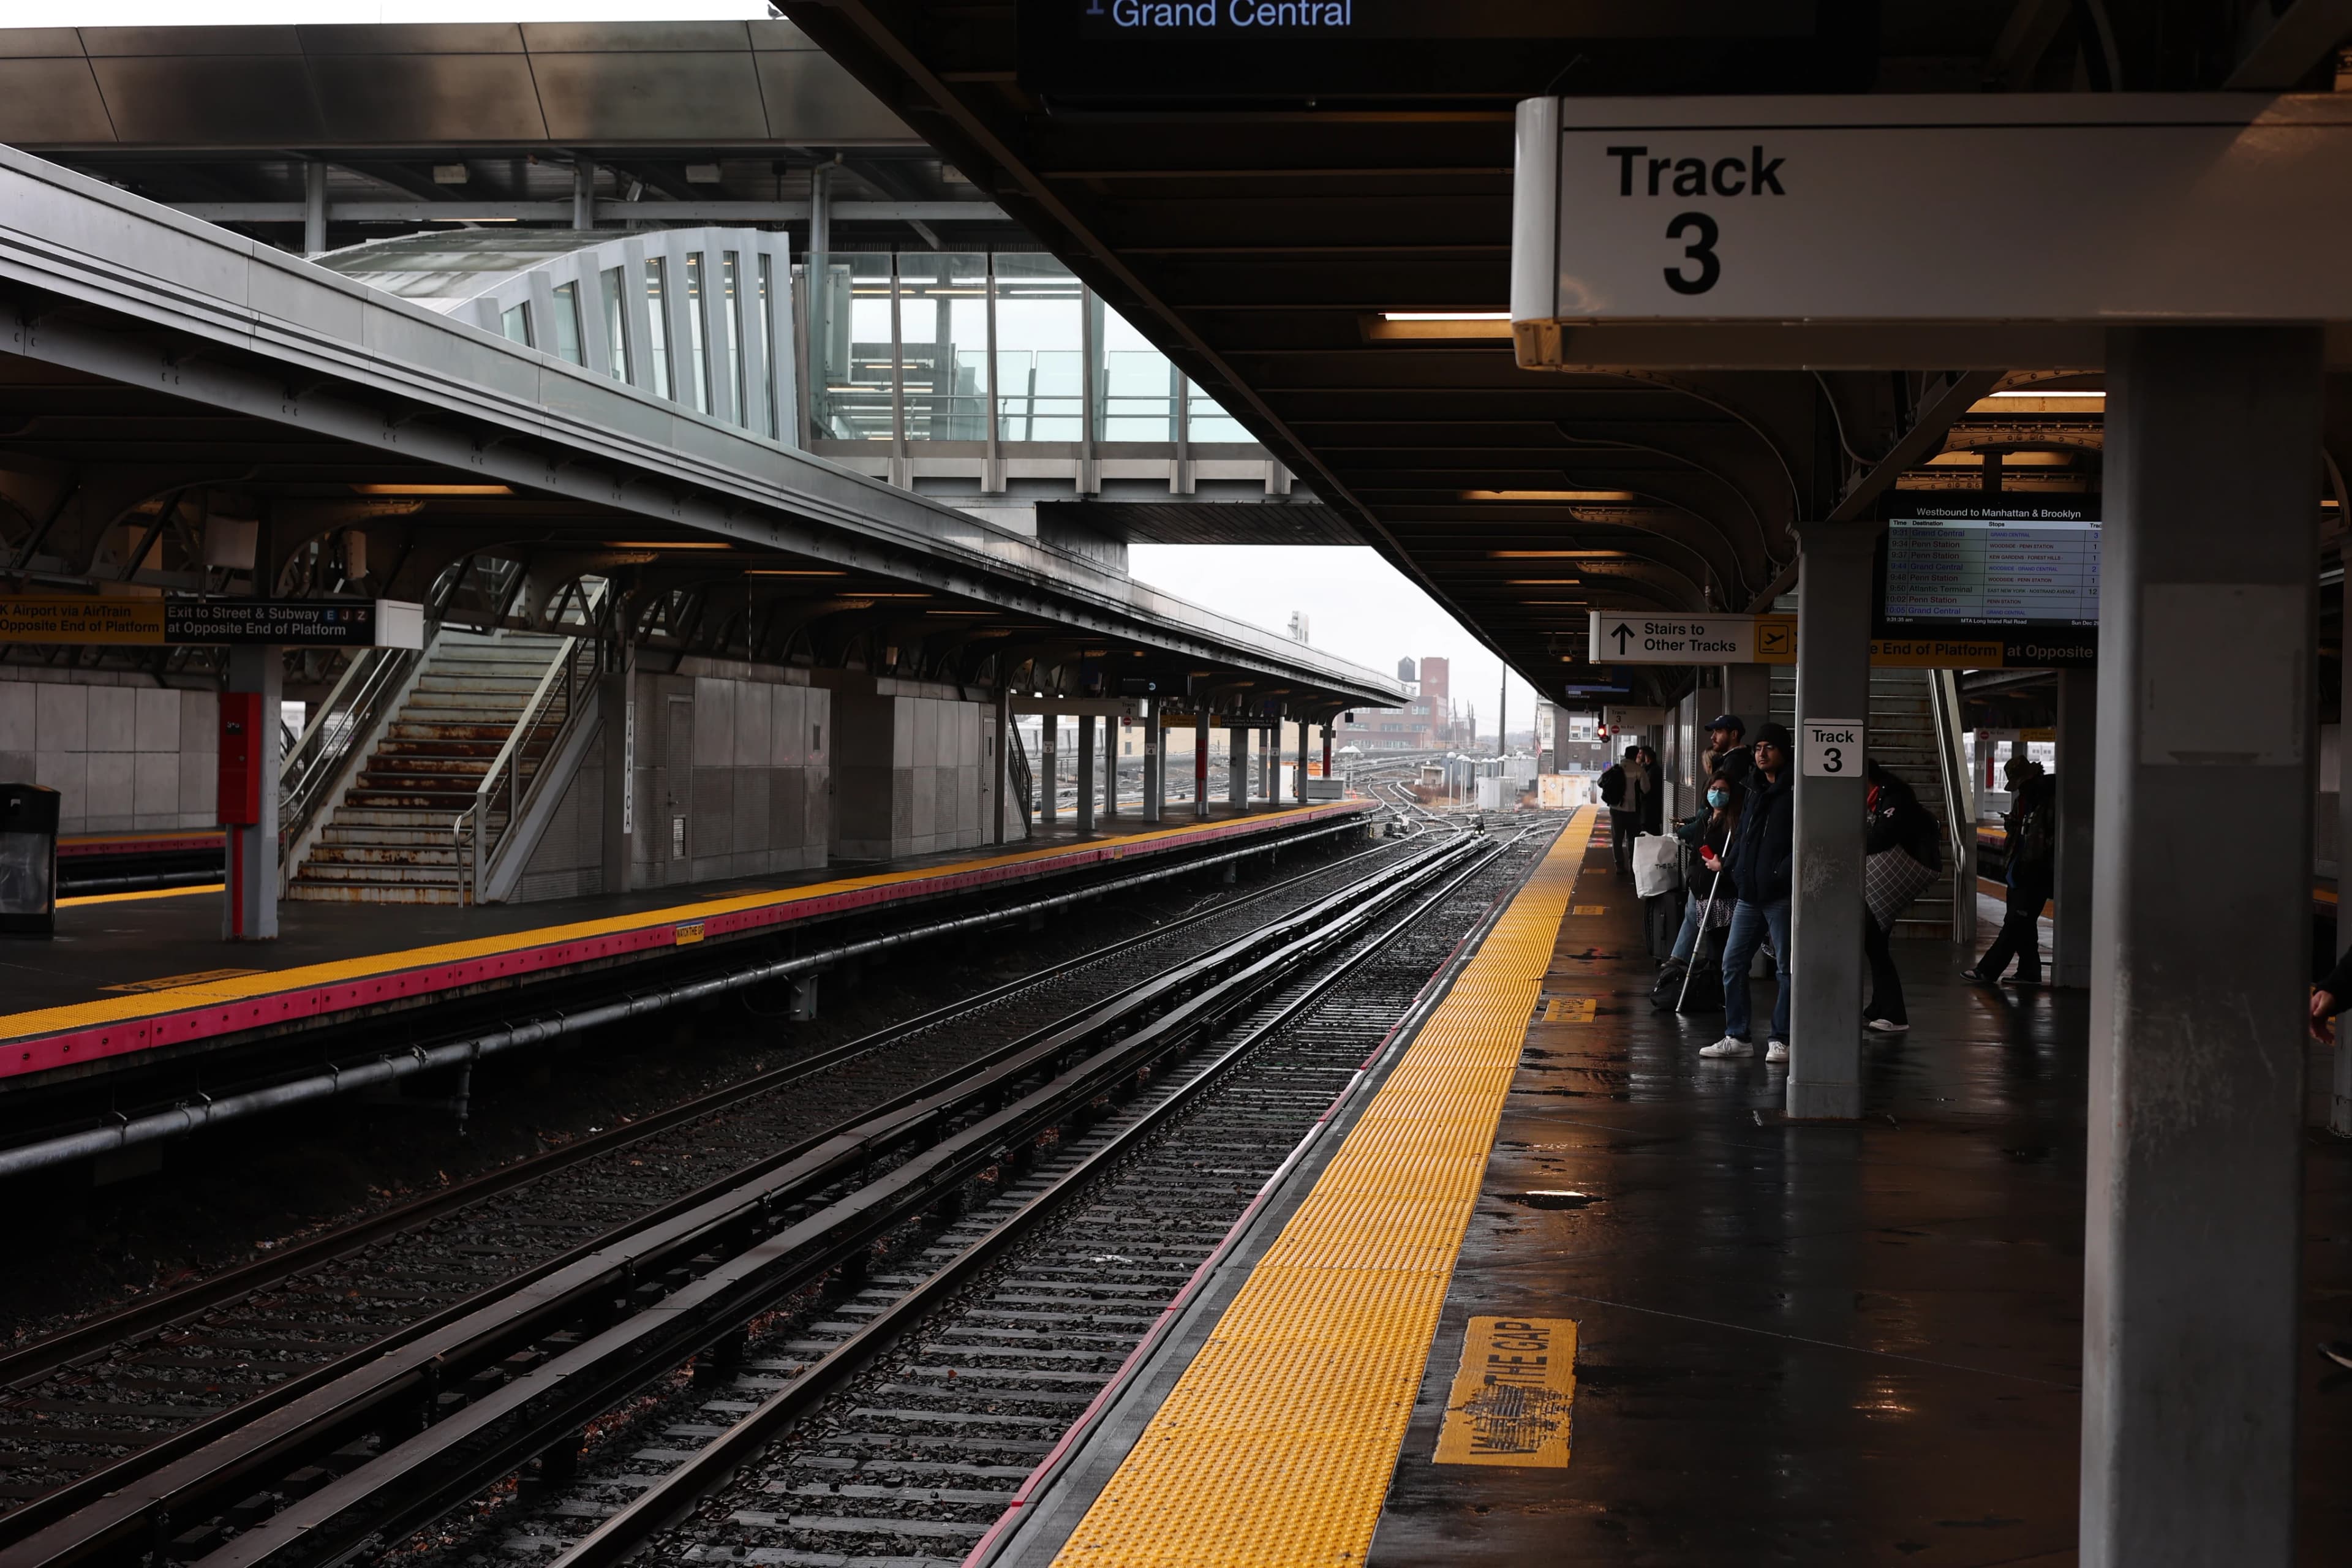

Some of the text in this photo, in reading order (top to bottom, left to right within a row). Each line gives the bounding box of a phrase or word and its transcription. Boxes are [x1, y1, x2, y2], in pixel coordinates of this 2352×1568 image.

[1112, 0, 1217, 27] Grand
[1229, 0, 1352, 27] Central
[1607, 146, 1786, 197] Track
[1664, 212, 1720, 295] 3
[1917, 508, 1967, 516] Westbound
[1981, 508, 2029, 518] Manhattan
[2041, 510, 2081, 519] Brooklyn
[13, 604, 56, 617] Airport
[61, 605, 79, 616] via
[83, 605, 131, 617] AirTrain
[167, 606, 366, 622] Exit to Street & Subway E J Z
[0, 620, 159, 633] Opposite End of Platform
[168, 622, 346, 636] at Opposite End of Platform
[1645, 622, 1705, 635] Stairs to
[1645, 639, 1736, 652] Other Tracks
[1883, 643, 1910, 655] End
[1915, 643, 1930, 655] of
[1935, 644, 1997, 657] Platform
[2007, 645, 2094, 661] at Opposite
[1812, 729, 1854, 743] Track
[1823, 748, 1842, 773] 3
[1883, 806, 1896, 818] 4
[677, 927, 689, 938] WATCH
[688, 925, 697, 936] THE
[1491, 1321, 1550, 1351] GAP
[1483, 1354, 1548, 1385] THE
